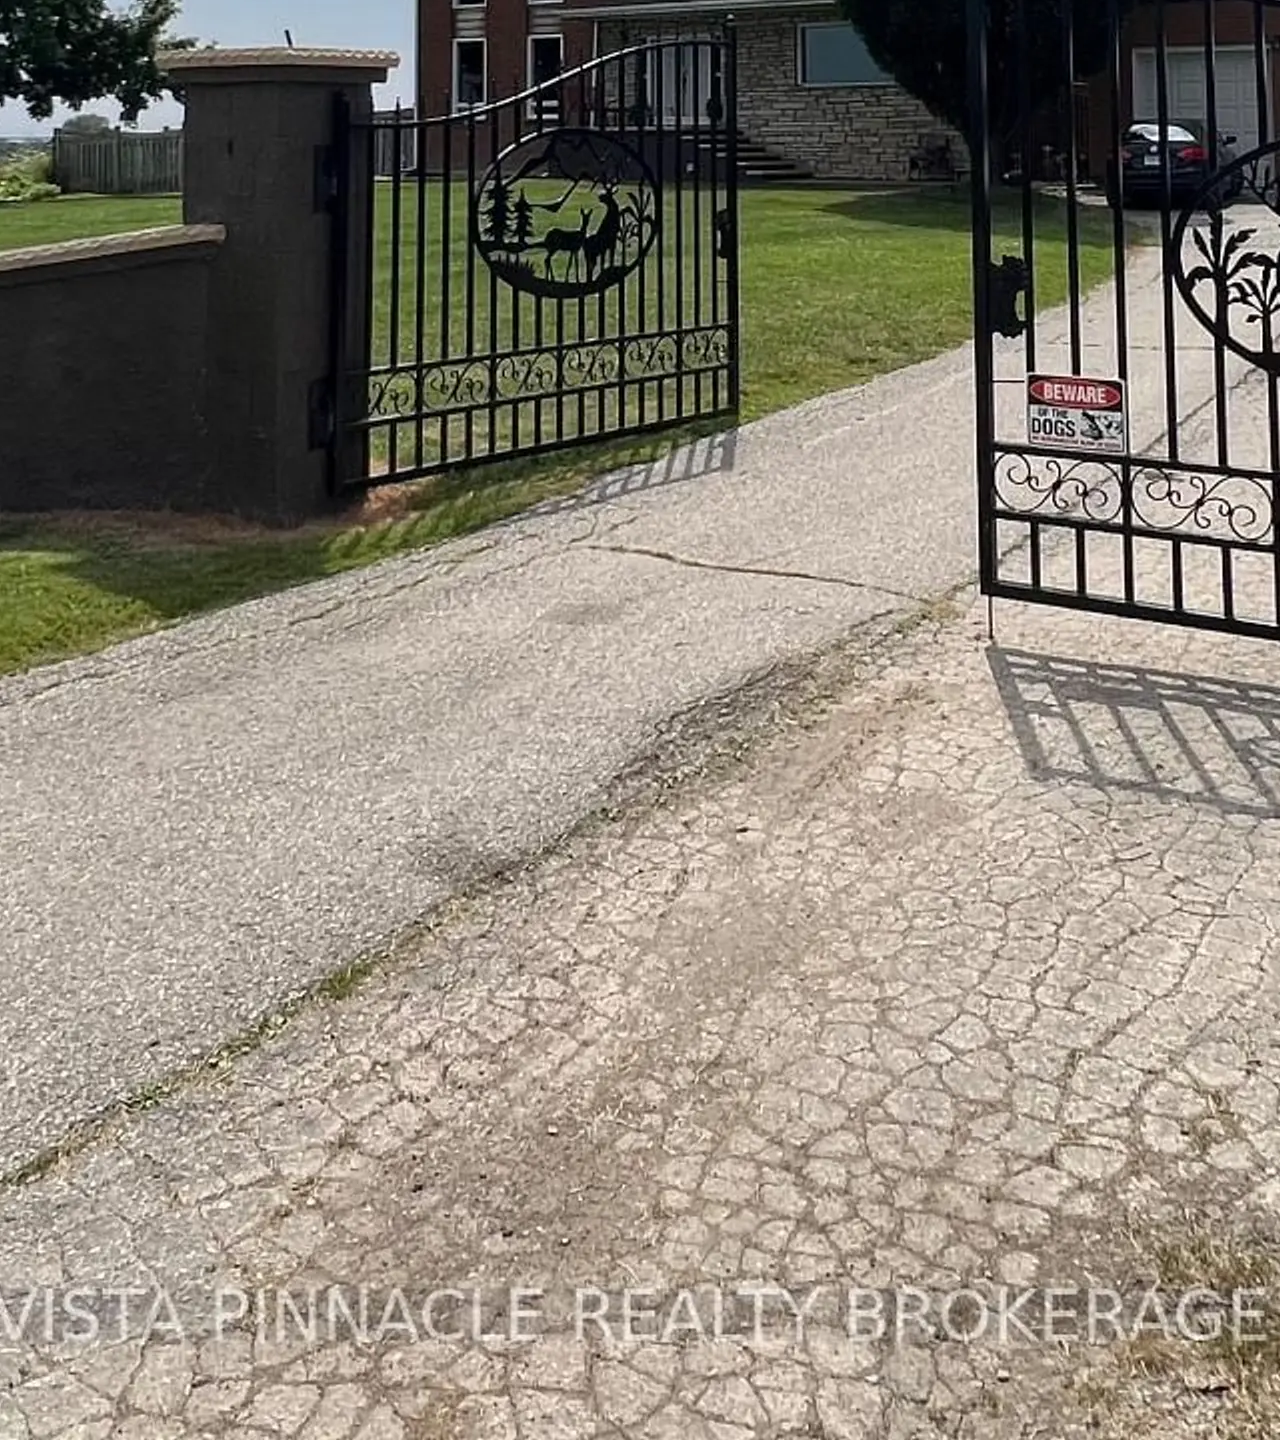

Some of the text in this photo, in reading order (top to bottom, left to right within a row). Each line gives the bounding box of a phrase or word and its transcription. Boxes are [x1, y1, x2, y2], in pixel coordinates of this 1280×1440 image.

[1043, 382, 1107, 404] BEWARE
[1052, 408, 1069, 419] THE
[1032, 418, 1076, 437] DOGS
